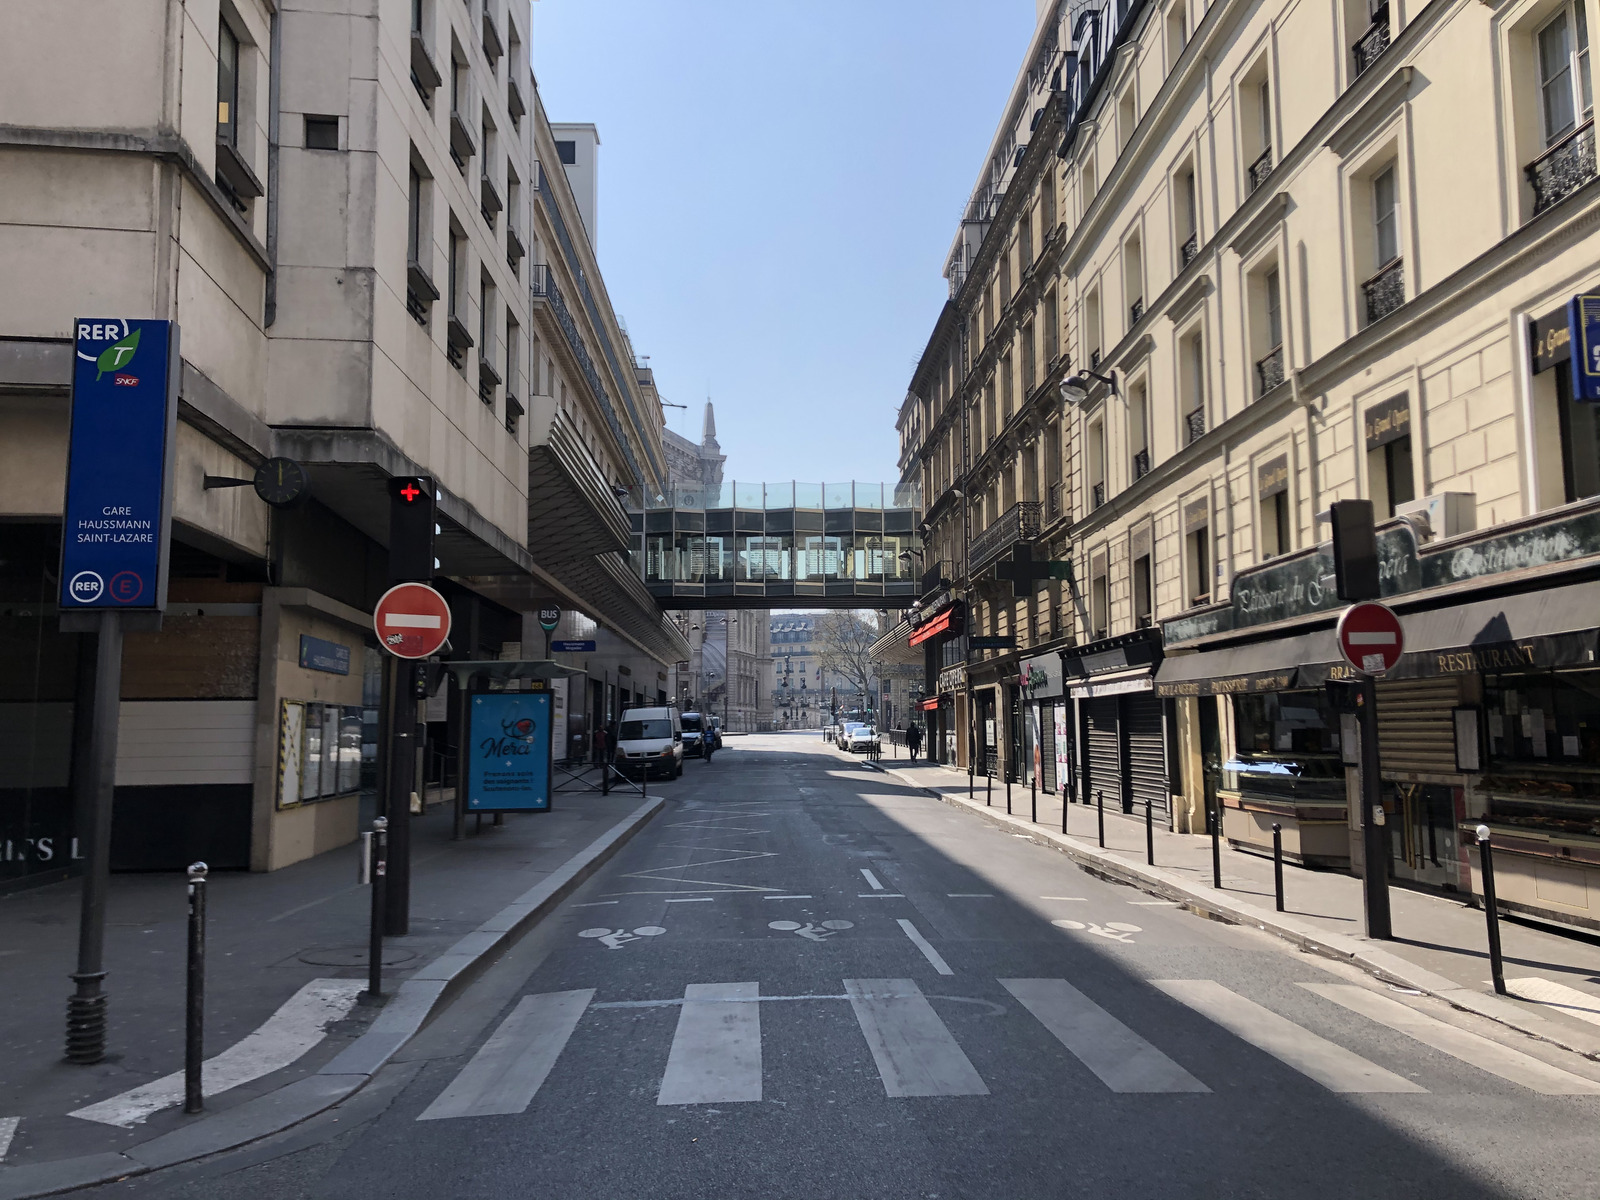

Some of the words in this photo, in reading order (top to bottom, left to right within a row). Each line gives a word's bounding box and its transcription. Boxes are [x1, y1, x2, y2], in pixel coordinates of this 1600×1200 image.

[78, 324, 119, 340] RER
[113, 347, 134, 366] T
[102, 506, 132, 516] GARE
[78, 519, 151, 529] HAUSSMANN
[77, 533, 153, 543] SAINT-LAZARE
[75, 581, 99, 592] RER
[120, 580, 132, 593] E
[541, 610, 557, 618] BUS
[1437, 645, 1535, 673] RESTAURANT
[1158, 683, 1200, 696] BOULANGERIE
[1211, 677, 1249, 694] PATISSERIE
[480, 737, 531, 759] Merci
